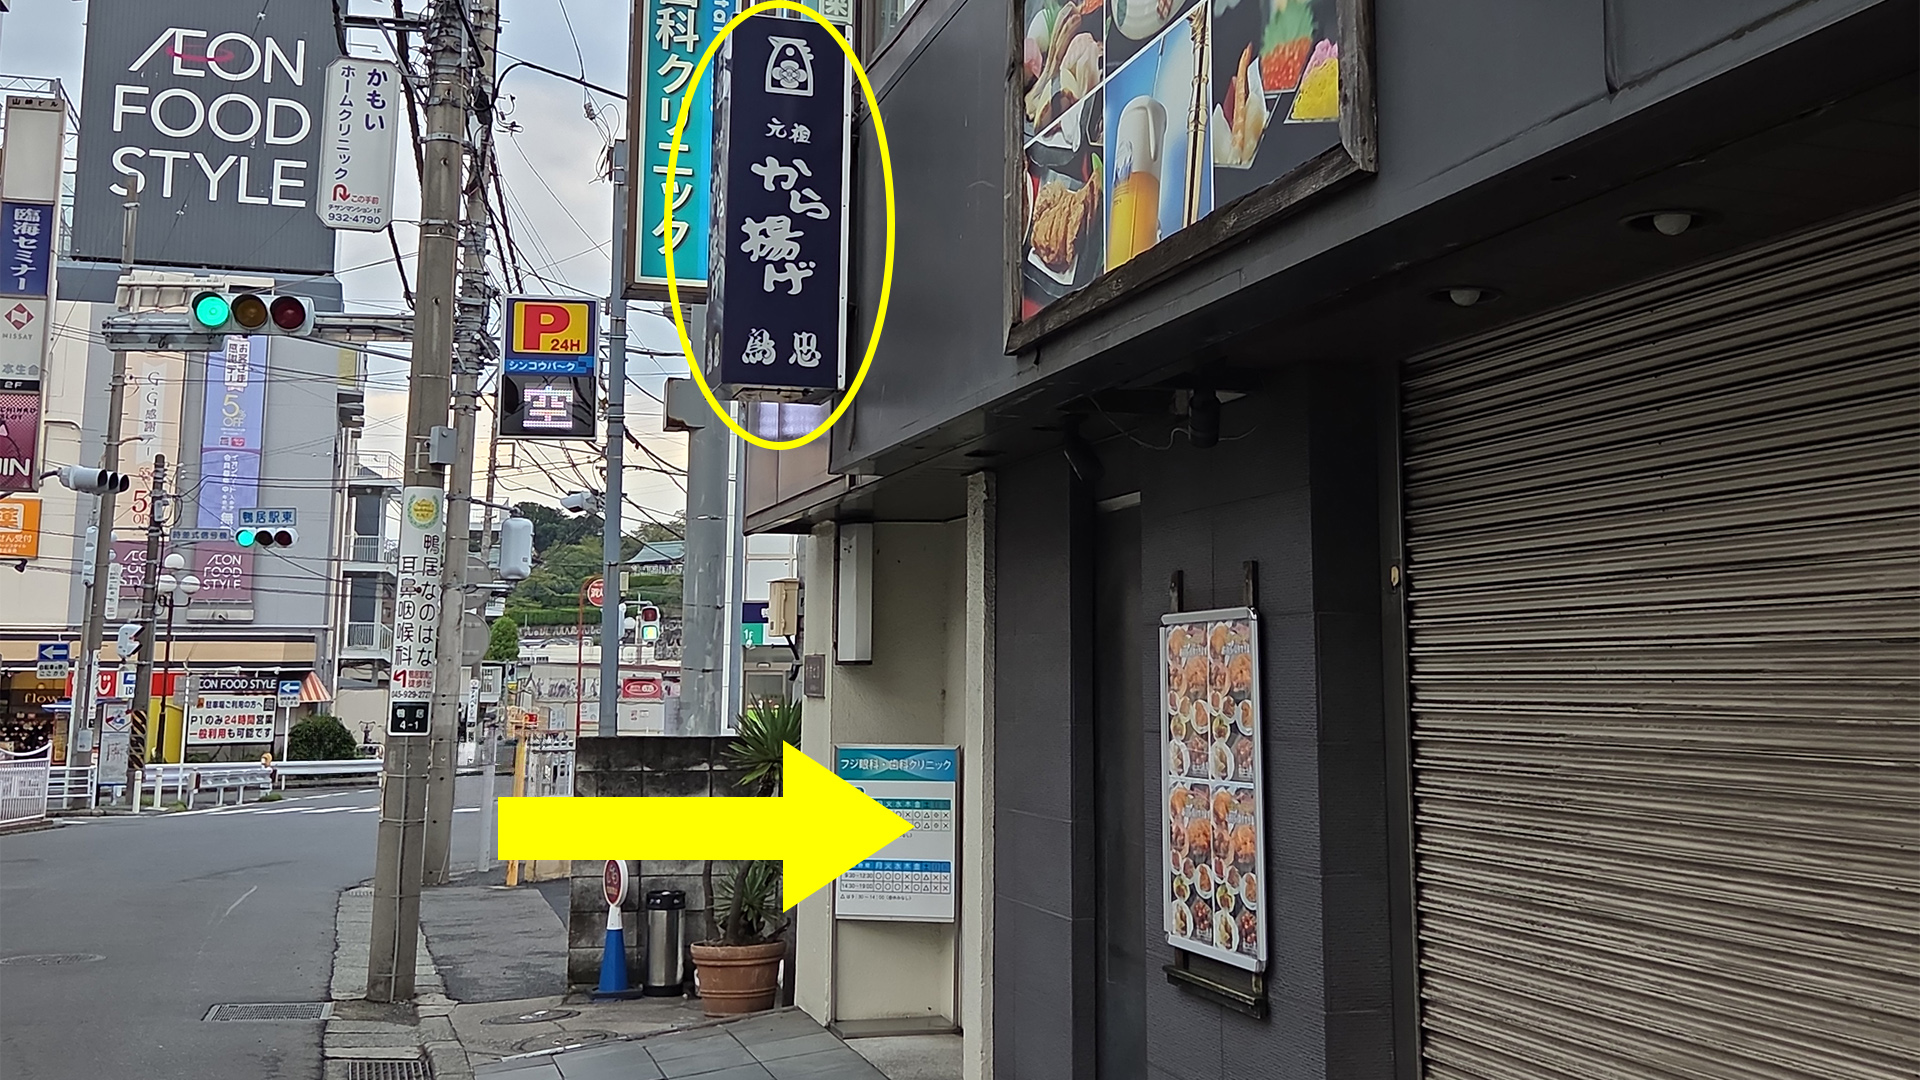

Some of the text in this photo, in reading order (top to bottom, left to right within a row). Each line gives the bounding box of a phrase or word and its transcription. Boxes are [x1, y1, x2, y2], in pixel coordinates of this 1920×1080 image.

[112, 84, 311, 145] FOOD
[365, 68, 388, 131] かもい
[334, 65, 356, 180] ホームクリニック
[652, 0, 700, 256] 科クリニック
[765, 117, 811, 144] 元祖
[109, 146, 308, 208] STYLE
[328, 212, 380, 225] 932-4790
[740, 156, 831, 295] から揚げ
[10, 208, 41, 291] 臨海セミナー
[2, 332, 33, 341] NISSAY
[523, 304, 571, 350] P
[550, 339, 581, 352] 24H
[4, 381, 23, 390] 2F
[522, 385, 573, 428] 空
[0, 458, 31, 476] IN
[242, 511, 293, 523] 鴨居駅東
[395, 556, 418, 667] 耳鼻咽喉科
[416, 534, 440, 667] 鴨居なのはな
[221, 679, 249, 689] FOOD
[250, 679, 277, 690] STYLE
[189, 728, 272, 739] 一般利用も可能です
[400, 720, 419, 730] 4-1
